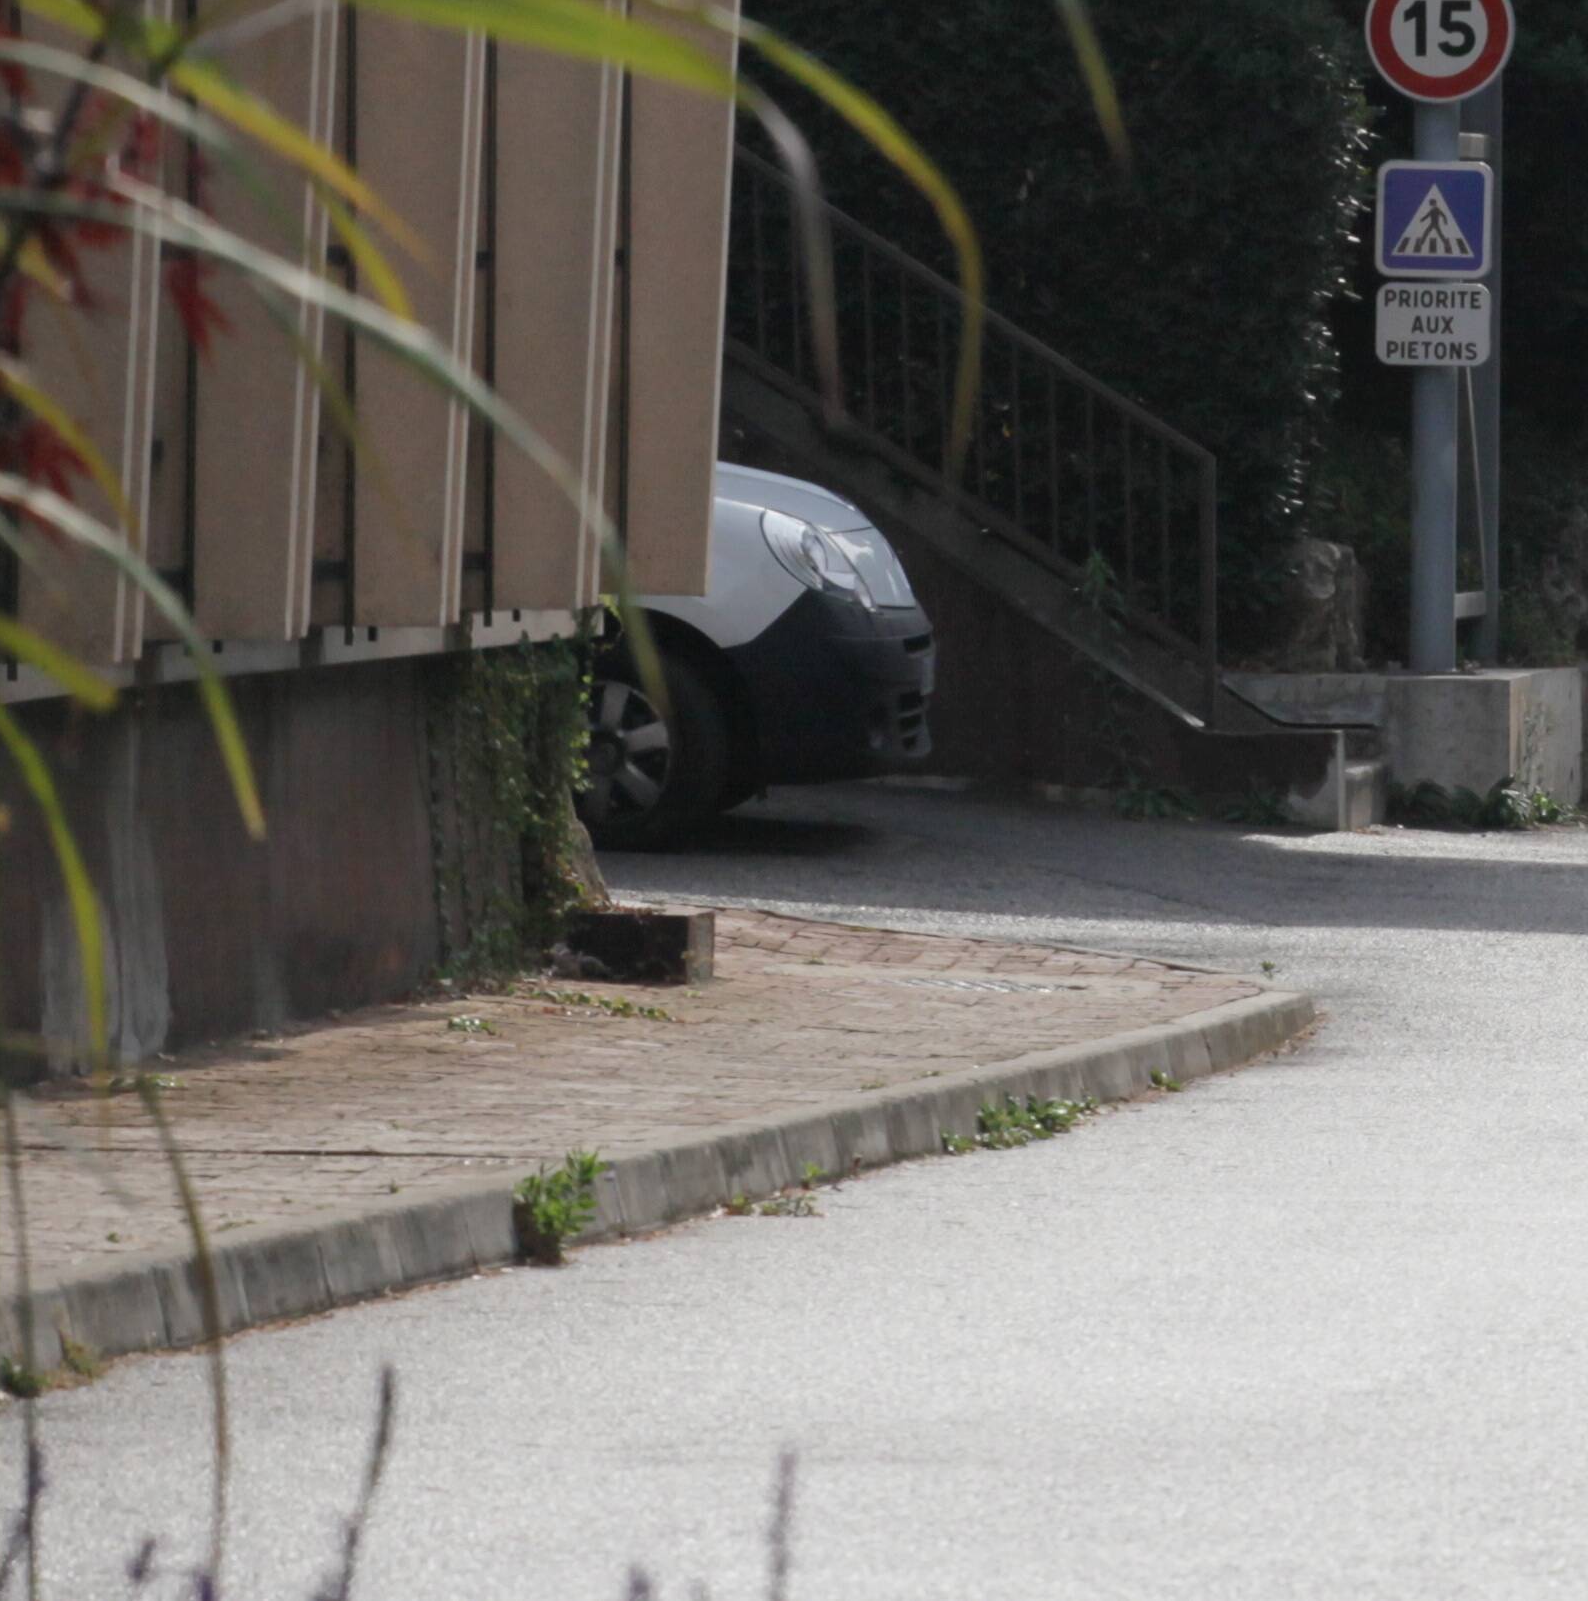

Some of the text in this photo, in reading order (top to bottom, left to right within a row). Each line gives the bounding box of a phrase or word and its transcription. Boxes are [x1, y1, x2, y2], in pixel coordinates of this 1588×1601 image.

[1403, 0, 1475, 57] 15
[1383, 289, 1482, 310] PRIORITE
[1411, 315, 1454, 334] AUX
[1386, 340, 1478, 361] PIETONS
